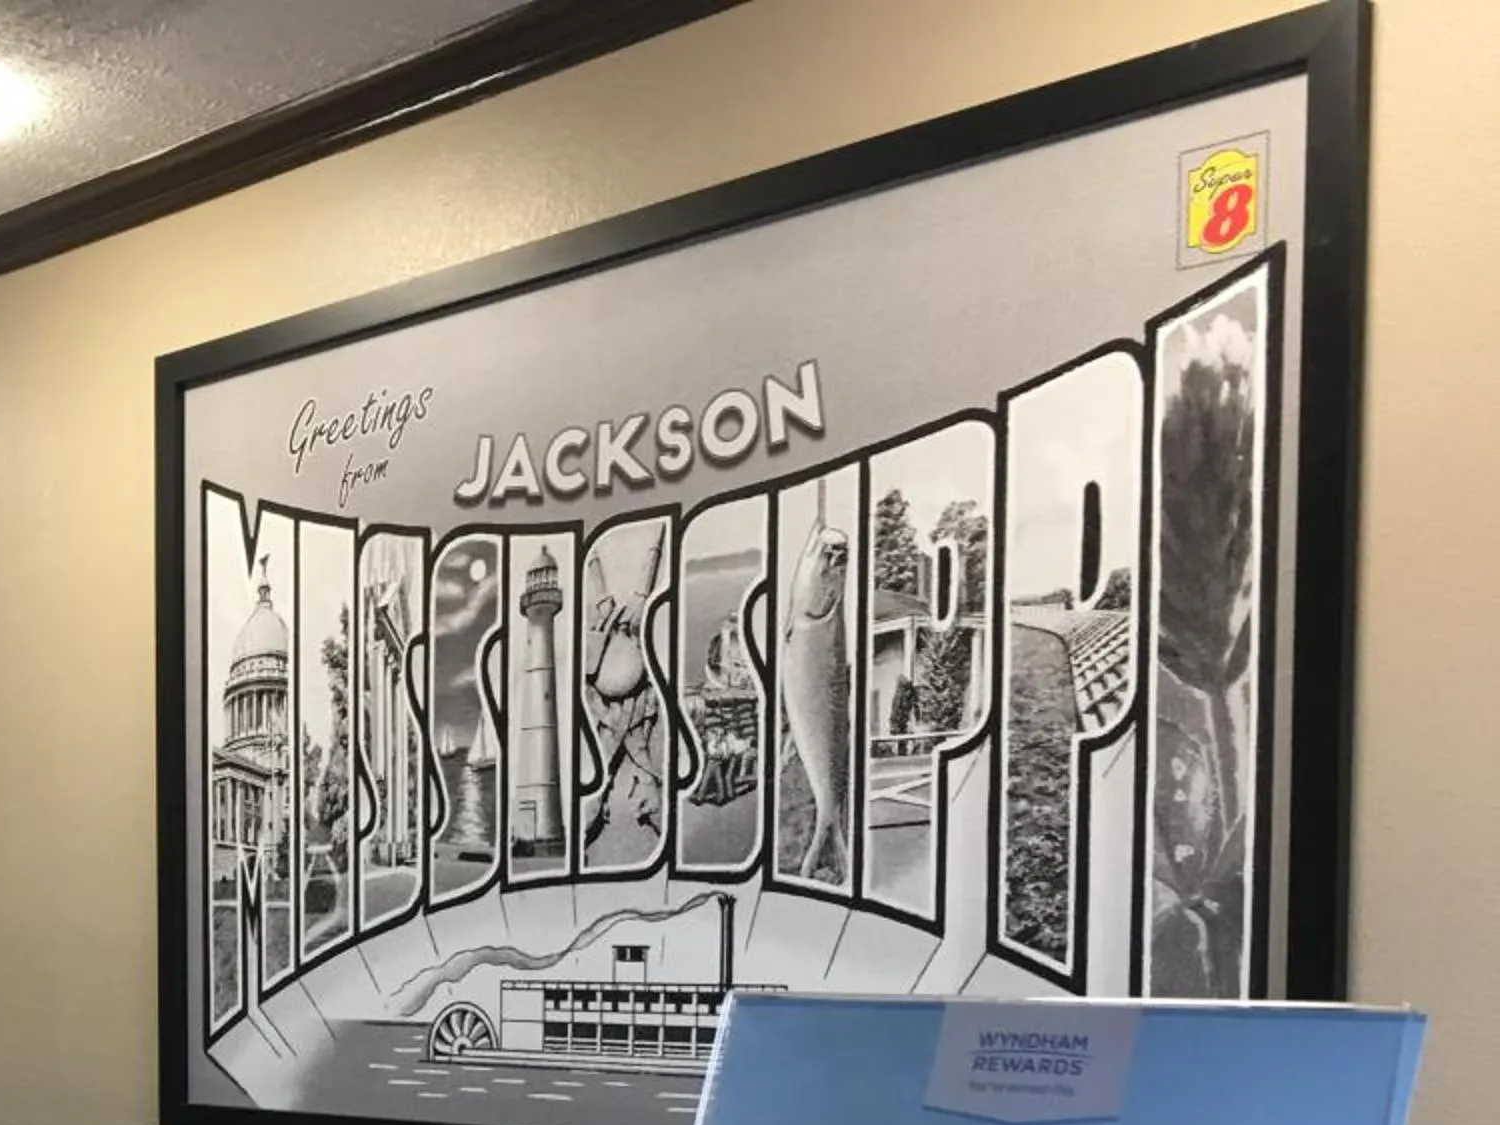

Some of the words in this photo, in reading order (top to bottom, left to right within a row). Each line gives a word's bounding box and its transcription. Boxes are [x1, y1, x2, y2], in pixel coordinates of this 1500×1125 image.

[1201, 183, 1254, 247] 8
[288, 384, 435, 474] Greetings
[453, 358, 826, 508] JACKSON
[337, 453, 389, 509] from
[200, 239, 1287, 1048] MISSISSIPPI
[971, 1056, 1085, 1076] REWARDS
[978, 1031, 1090, 1050] WYNDHAM
